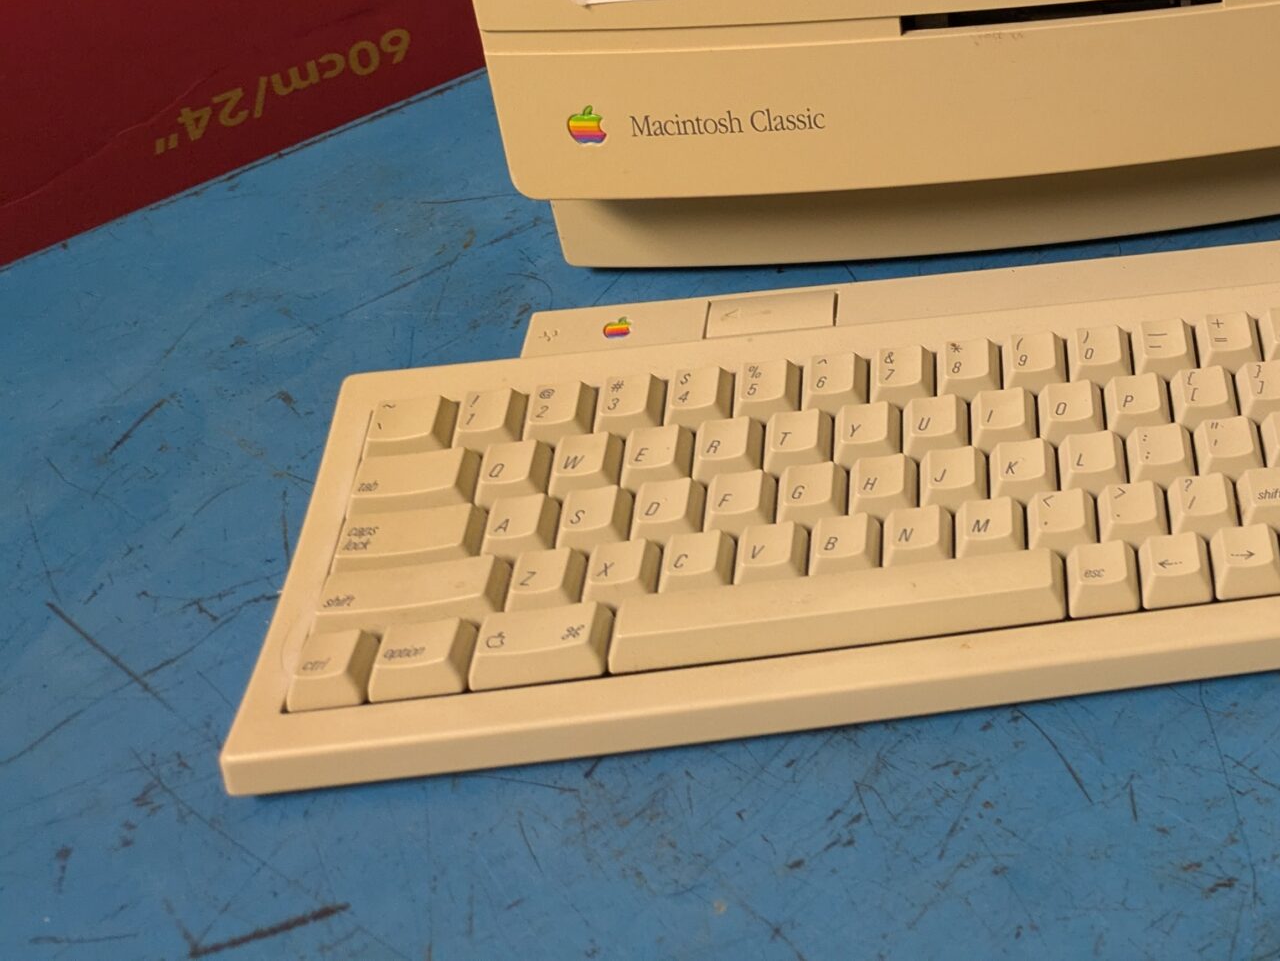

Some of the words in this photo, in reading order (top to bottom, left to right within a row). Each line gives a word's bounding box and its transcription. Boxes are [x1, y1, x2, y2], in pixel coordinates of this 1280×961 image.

[154, 28, 411, 156] 60cm/24"
[629, 109, 744, 137] Macintosh
[750, 107, 826, 133] Classic
[1018, 354, 1028, 367] 9
[1084, 348, 1094, 360] 0
[952, 361, 962, 374] 8
[884, 369, 895, 381] 7
[747, 383, 758, 396] 5
[816, 376, 827, 389] 6
[607, 397, 620, 411] 3
[678, 391, 690, 403] 4
[1122, 395, 1134, 408] P
[535, 405, 549, 419] 2
[987, 409, 993, 423] I
[1055, 402, 1067, 416] O
[465, 413, 476, 425] 1
[918, 417, 931, 431] U
[850, 424, 861, 438] Y
[779, 432, 792, 446] T
[706, 440, 721, 454] R
[634, 447, 649, 462] E
[1076, 453, 1084, 467] L
[563, 455, 584, 470] W
[1005, 461, 1018, 475] K
[488, 463, 505, 478] Q
[934, 469, 947, 483] J
[863, 477, 878, 491] H
[791, 485, 805, 499] G
[718, 493, 732, 508] F
[644, 501, 661, 516] D
[569, 509, 585, 524] S
[494, 518, 510, 533] A
[972, 519, 990, 533] M
[898, 528, 914, 542] N
[823, 536, 838, 551] B
[751, 545, 765, 559] V
[673, 553, 688, 569] C
[596, 562, 615, 577] X
[518, 571, 537, 586] Z
